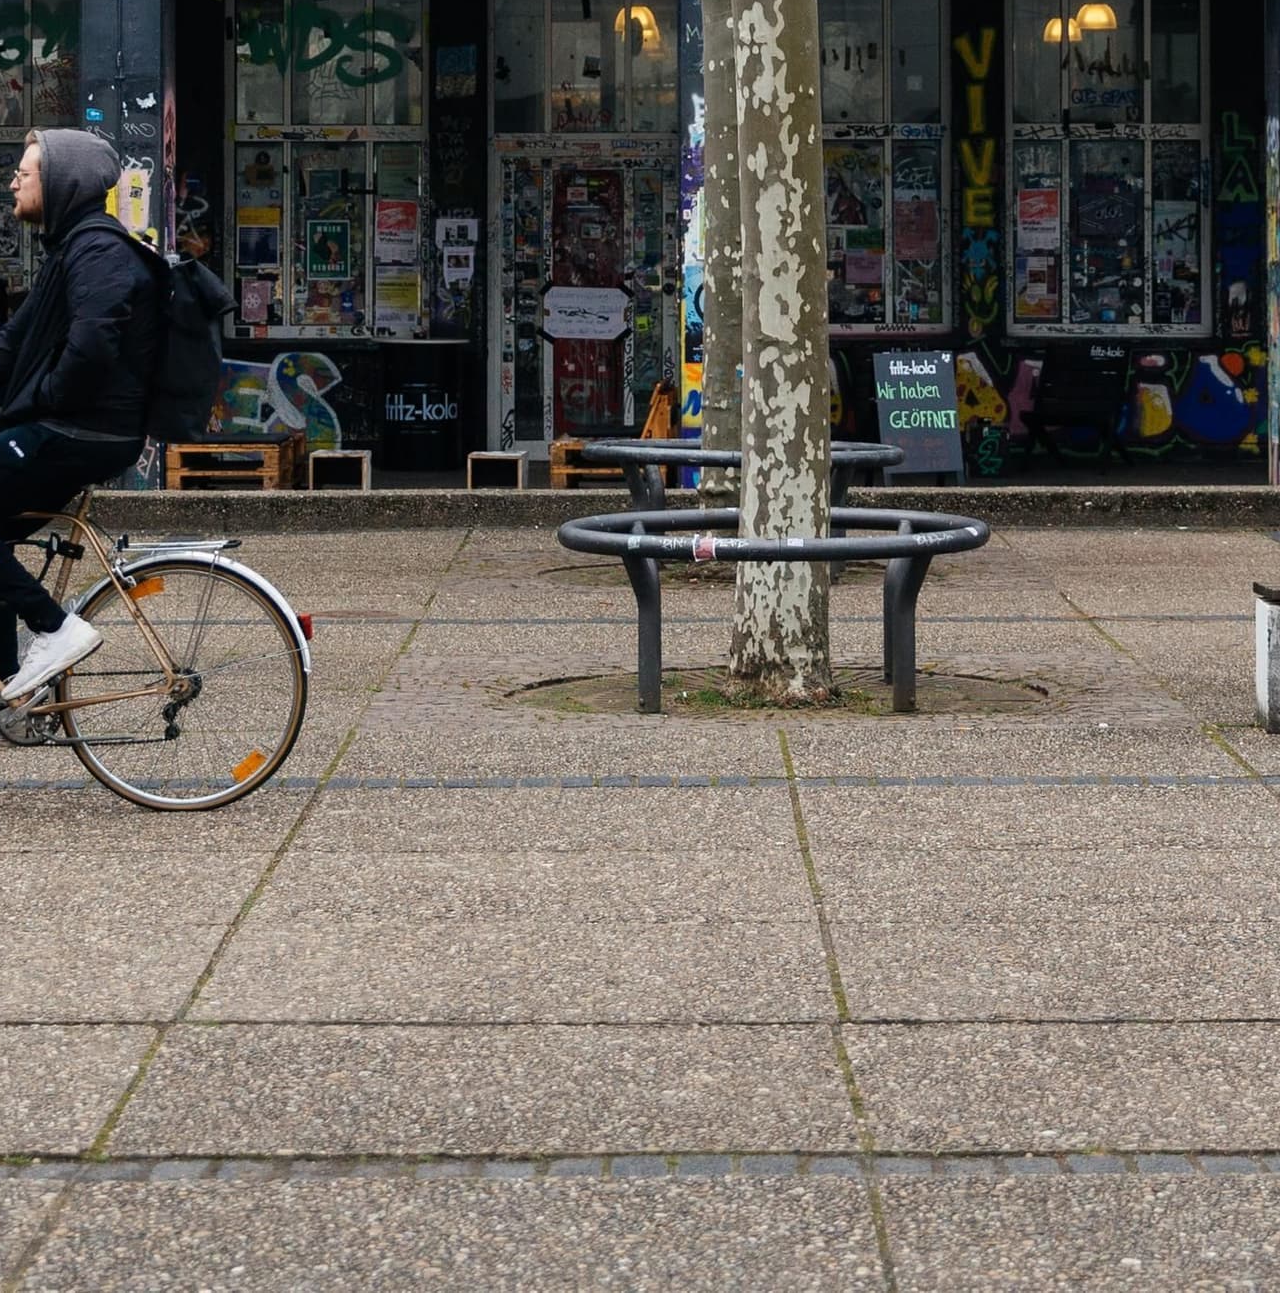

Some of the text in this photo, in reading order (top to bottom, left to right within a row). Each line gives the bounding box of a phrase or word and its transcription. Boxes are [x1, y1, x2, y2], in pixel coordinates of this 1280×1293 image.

[958, 26, 997, 227] VIVE
[889, 359, 937, 375] fritz-kola
[876, 381, 941, 400] Wir haben
[385, 393, 459, 422] fritz-kola
[889, 408, 958, 429] GEÖFFNET
